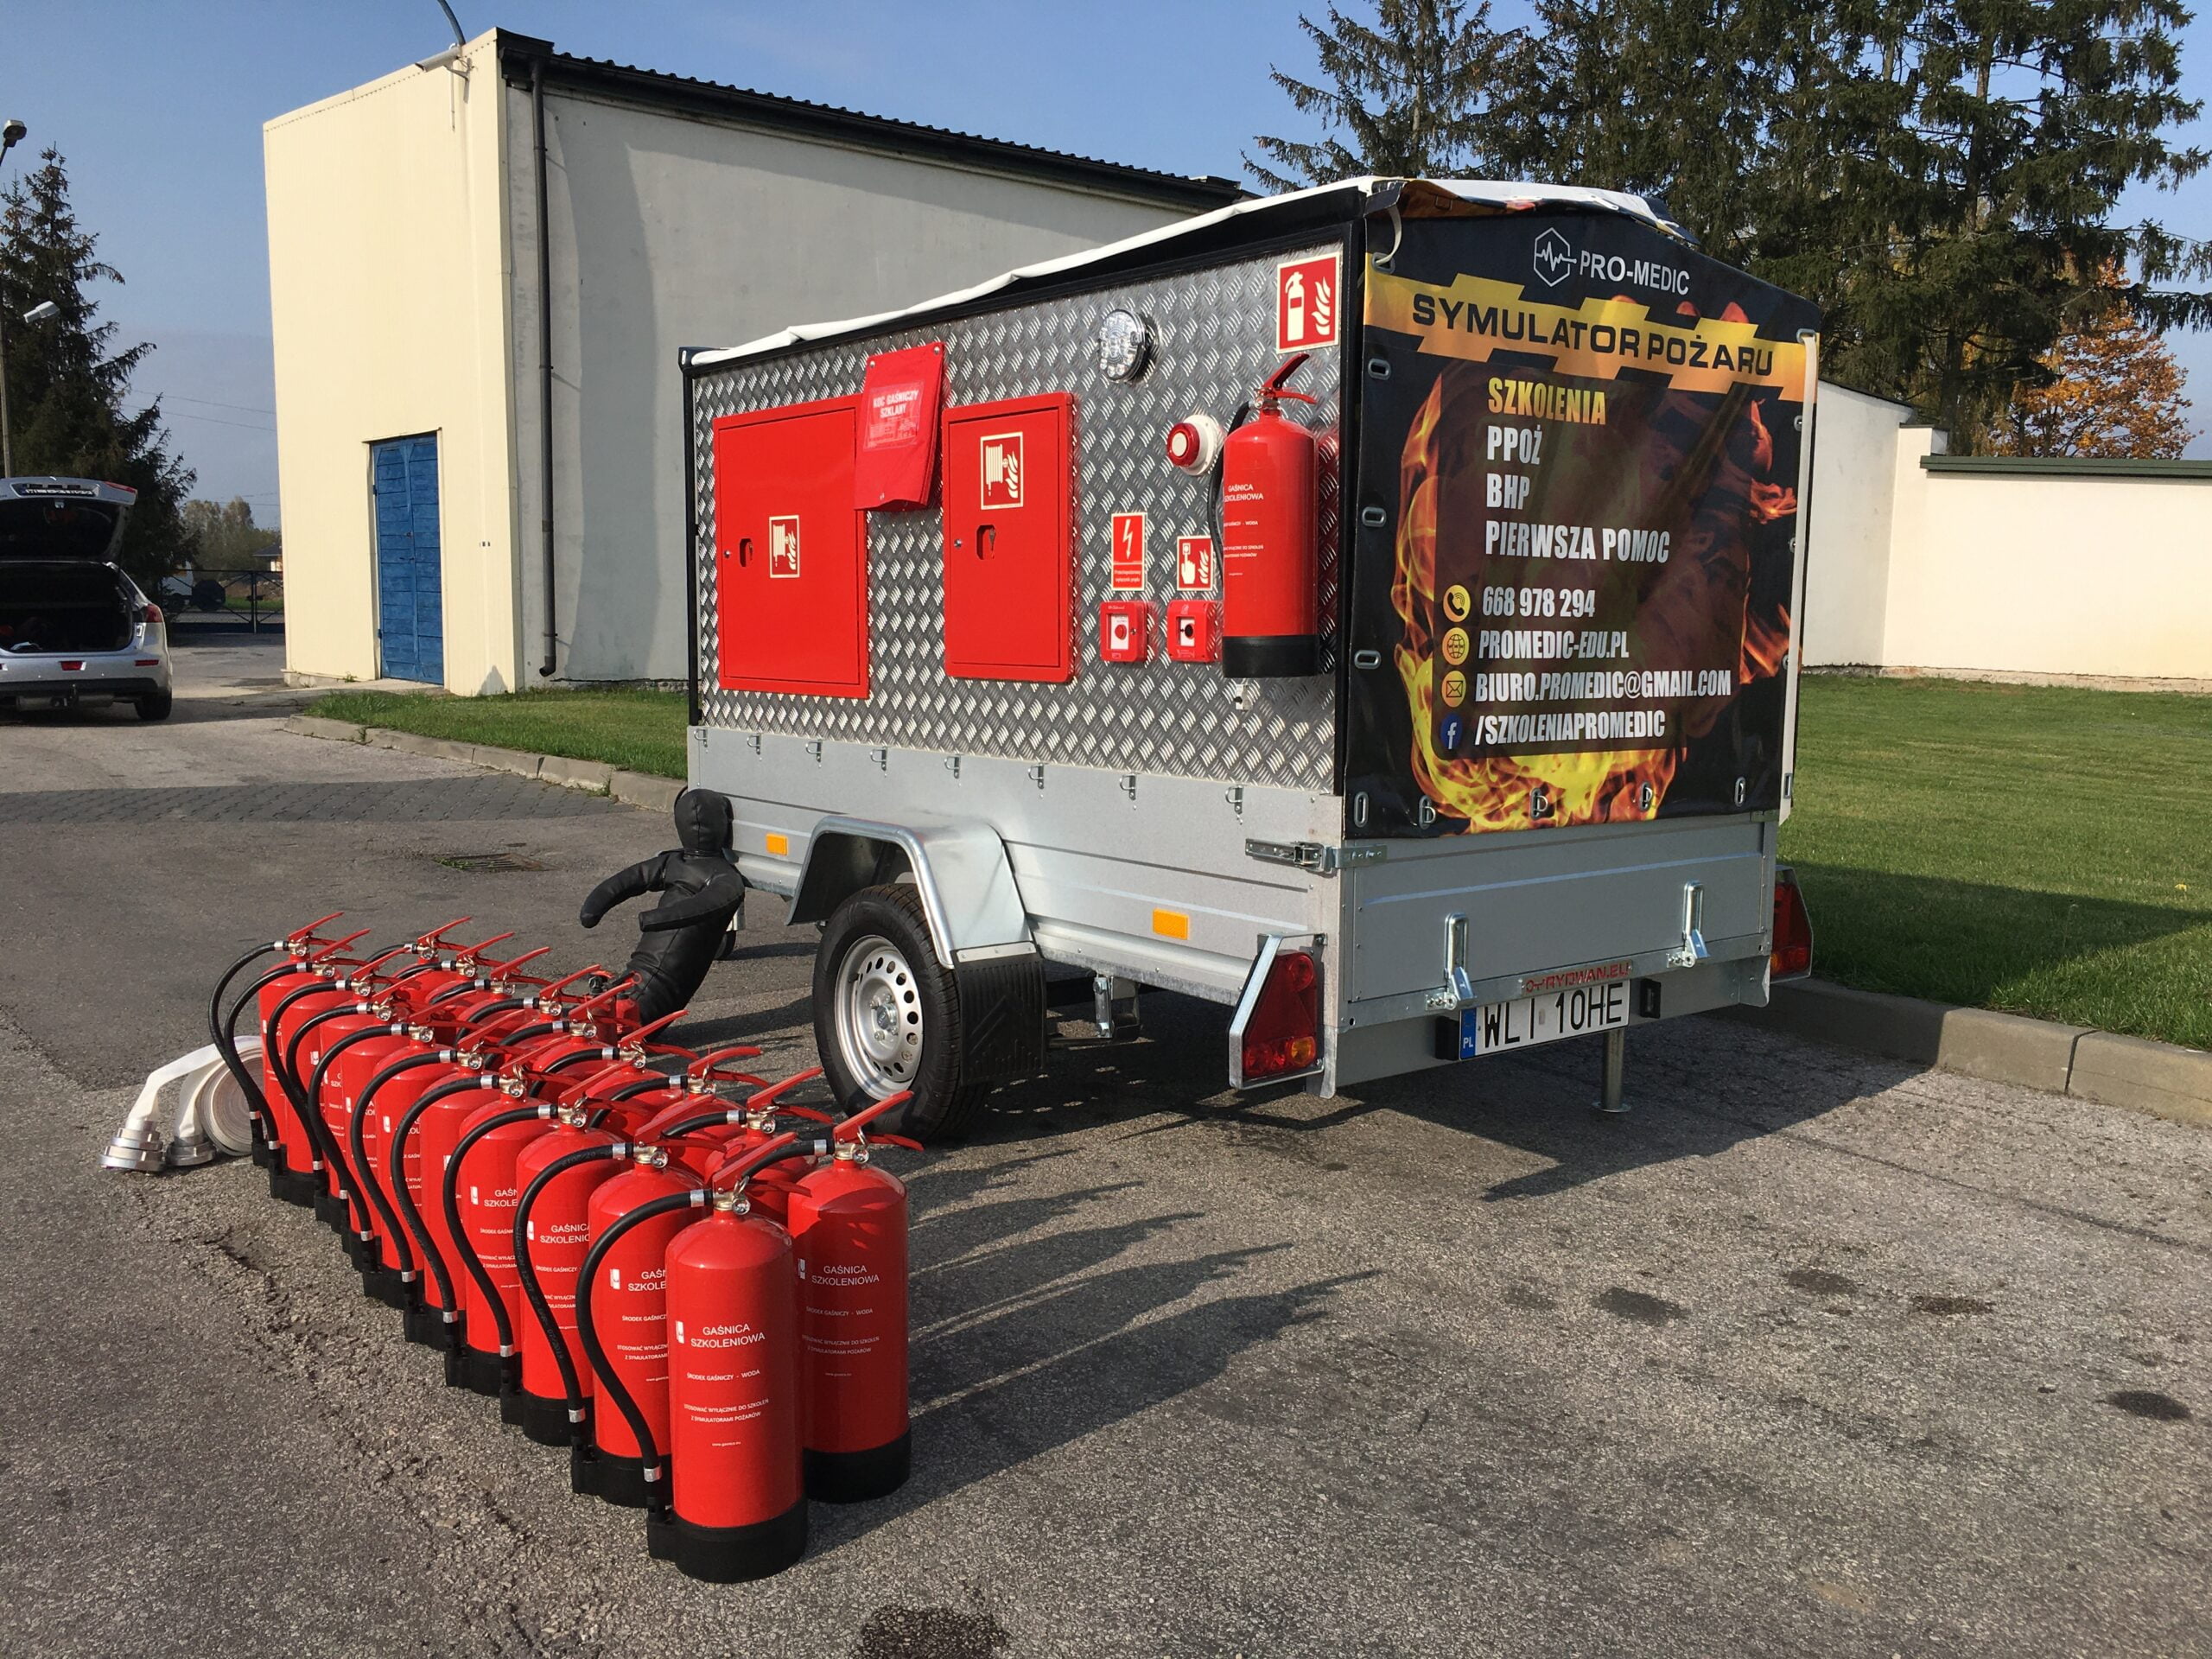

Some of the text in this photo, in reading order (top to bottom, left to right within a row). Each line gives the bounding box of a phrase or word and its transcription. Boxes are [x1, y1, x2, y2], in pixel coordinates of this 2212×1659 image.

[1579, 250, 1690, 296] PRO-MEDIC
[1412, 293, 1773, 377] SYMULATOR POŻARU
[880, 403, 906, 418] SZKLANY
[1486, 376, 1607, 426] SZKOLENIA
[1486, 423, 1543, 466] PPOŻ
[1228, 483, 1254, 493] GAŚNICA
[1486, 473, 1531, 511] BHP
[1484, 520, 1670, 564] PIERWSZA POMOC
[1482, 586, 1596, 618] 668 978 294
[1478, 629, 1630, 660] PROMEDIC-EDU.PL
[1475, 669, 1732, 702] BIURO.PROMEDIC@GMAIL.COM
[1474, 709, 1666, 746] /SZKOLENIAPROMEDIC
[1545, 963, 1630, 990] RYDWAN.EU
[1554, 982, 1624, 1034] 10HE
[1463, 1036, 1474, 1048] PL
[483, 1198, 518, 1208] SZKOLE
[810, 1274, 880, 1287] SZKOLENIOWA
[823, 1264, 868, 1275] GAŚNICA
[627, 1281, 666, 1292] SZKOLE
[855, 1307, 874, 1316] WODA
[690, 1332, 766, 1349] SZKOLENIOWA
[702, 1323, 751, 1337] GAŚNICA
[686, 1371, 706, 1381] ŚRODEK
[741, 1369, 760, 1378] WODA
